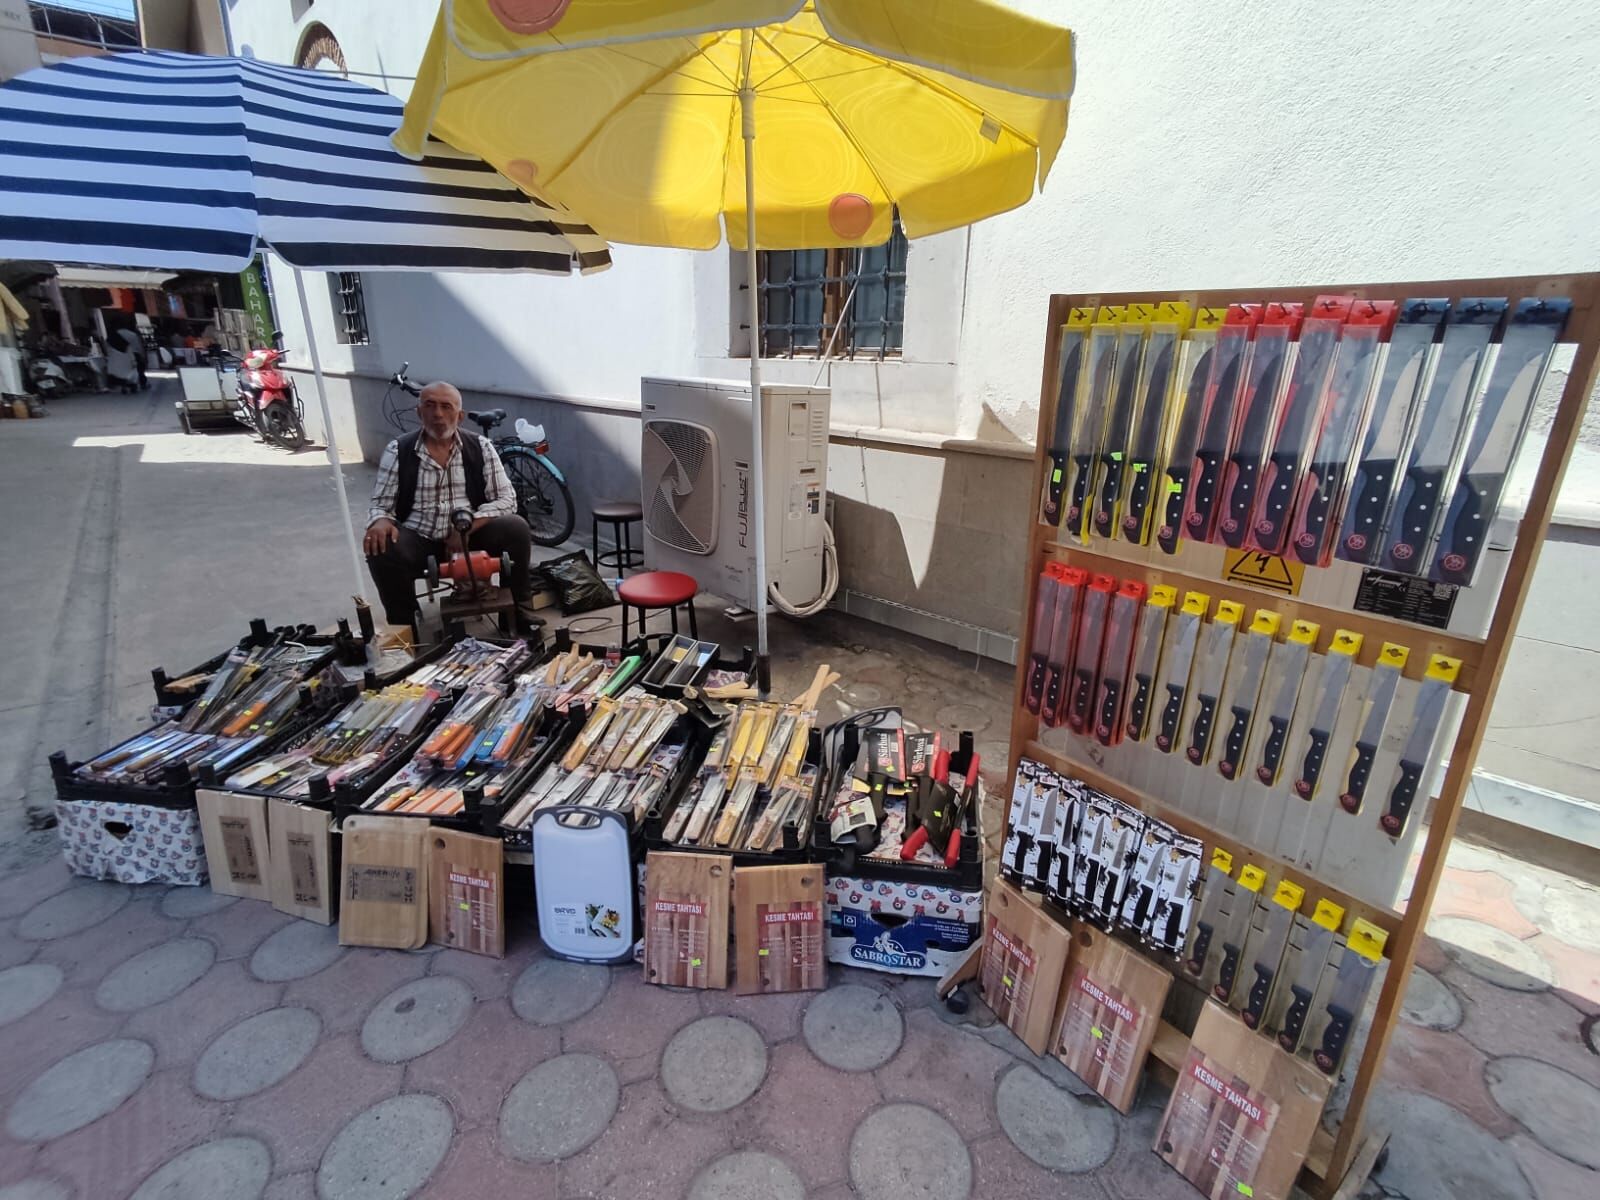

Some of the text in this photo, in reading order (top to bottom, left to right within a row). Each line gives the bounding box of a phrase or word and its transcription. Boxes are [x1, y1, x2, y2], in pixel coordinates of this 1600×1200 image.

[246, 272, 268, 348] BAHAR
[655, 902, 702, 914] KESME TAHTASI
[765, 911, 814, 923] KESME TAHTASI
[853, 947, 921, 968] SABROSTAR
[1081, 978, 1104, 1002] KESME
[1104, 995, 1133, 1022] TAHTASI
[1194, 1065, 1224, 1094] KESME
[1224, 1087, 1261, 1121] TAHTASI
